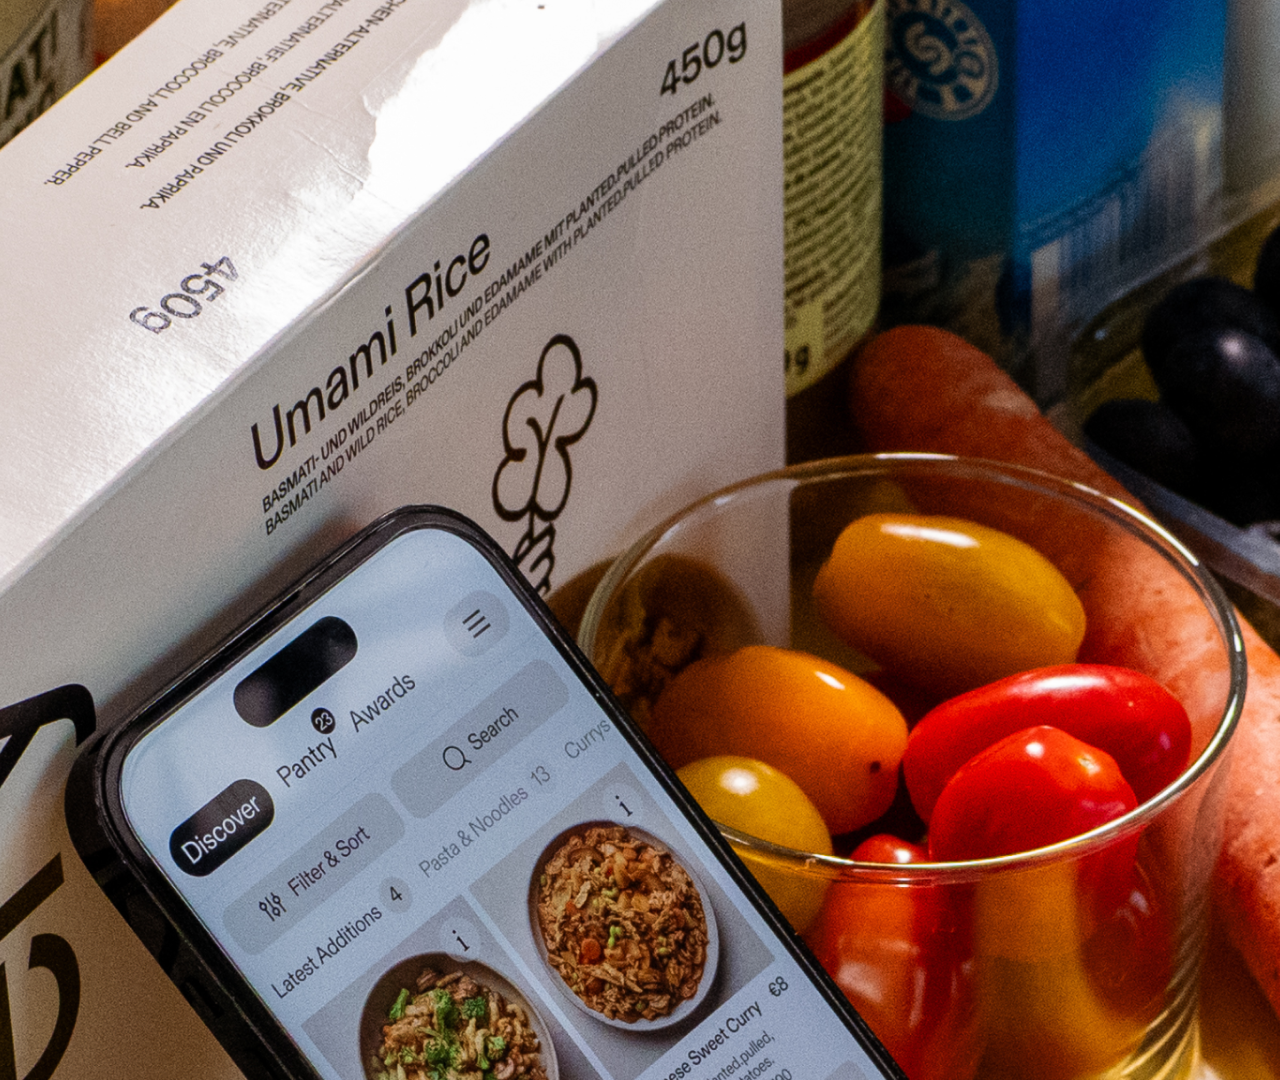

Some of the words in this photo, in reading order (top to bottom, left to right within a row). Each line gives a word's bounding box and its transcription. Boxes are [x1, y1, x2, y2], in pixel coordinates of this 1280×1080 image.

[148, 49, 224, 99] BROCCOLI,
[660, 21, 747, 97] 450g
[126, 98, 158, 122] AND
[199, 61, 267, 112] BROCCOLI
[93, 121, 132, 145] BELL
[180, 111, 207, 128] EN
[224, 91, 291, 144] BROKKOLI
[44, 145, 103, 185] PEPPER.
[125, 126, 188, 168] PAPRIKA.
[197, 141, 232, 166] UND
[140, 164, 204, 209] PAPRIKA.
[130, 253, 239, 335] 450g
[262, 455, 320, 513] BASMATI-
[321, 428, 348, 460] UND
[348, 376, 406, 436] WILDREIS,
[406, 319, 458, 382] BROKKOLI
[459, 296, 483, 329] UND
[485, 240, 543, 304] EDAMAME
[544, 219, 566, 251] MIT
[658, 93, 716, 143] PROTEIN.
[265, 478, 318, 535] BASMATI
[320, 455, 345, 489] AND
[346, 427, 375, 462] WILD
[377, 400, 406, 435] RICE,
[406, 343, 459, 408] BROCCOLI
[460, 319, 483, 352] AND
[485, 263, 542, 327] EDAMAME
[542, 236, 572, 272] WITH
[666, 110, 723, 160] PROTEIN.
[251, 305, 397, 470] Umami
[405, 233, 491, 338] Rice
[467, 704, 519, 750] Search
[181, 794, 261, 865] Discover
[276, 737, 338, 787] Pantry
[314, 712, 333, 731] 23
[349, 672, 416, 733] Awards
[271, 956, 319, 999] Latest
[316, 906, 383, 964] Additions
[389, 886, 403, 902] 4
[418, 843, 461, 878] Pasta
[457, 829, 475, 847] &
[469, 783, 529, 839] Noodles
[530, 765, 551, 786] 13
[564, 719, 611, 760] Currys
[288, 860, 327, 897] Filter
[324, 849, 341, 868] &
[336, 825, 371, 858] Sort
[687, 1027, 730, 1067] Sweet
[724, 1001, 763, 1036] Curry
[768, 975, 790, 998] €8
